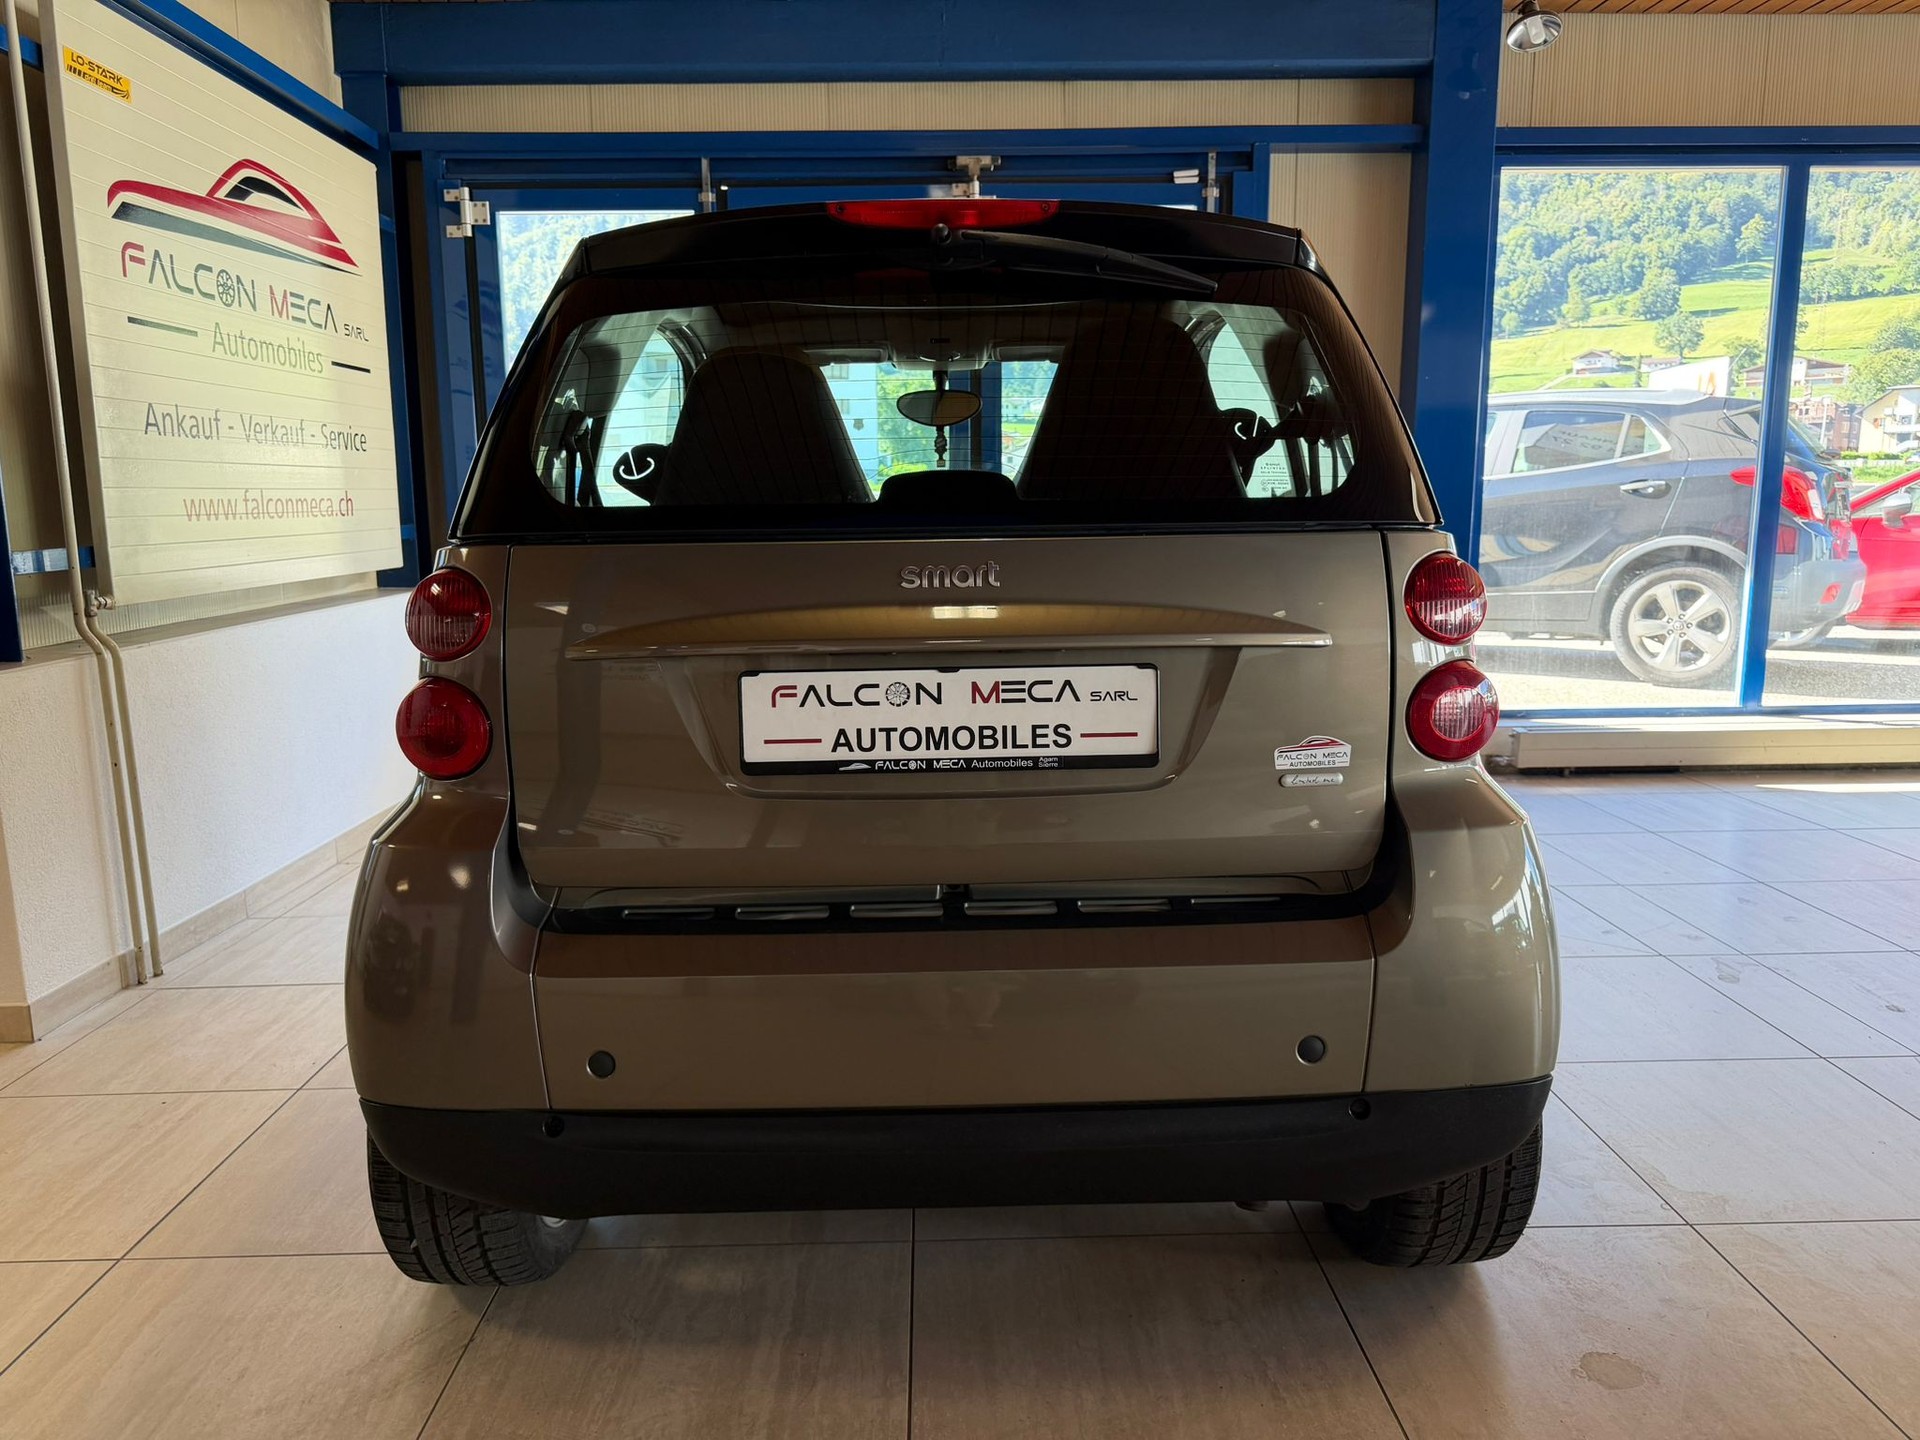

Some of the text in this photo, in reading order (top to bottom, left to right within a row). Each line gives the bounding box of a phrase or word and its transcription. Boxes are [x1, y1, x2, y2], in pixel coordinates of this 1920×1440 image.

[71, 52, 123, 87] LO-STARK
[121, 241, 370, 342] FALCON MECA SARL
[212, 321, 324, 374] Automobiles
[144, 402, 221, 441] Ankauf
[239, 413, 306, 448] Verkauf
[319, 423, 367, 452] Service
[182, 489, 354, 522] www.falconmeca.ch
[900, 560, 1000, 589] smart
[771, 679, 1139, 708] FALCON MECA SARL
[831, 723, 1073, 753] AUTOMOBILES
[875, 758, 1034, 770] FALCON MECA Automobiles
[1276, 751, 1348, 761] FALCON MECA
